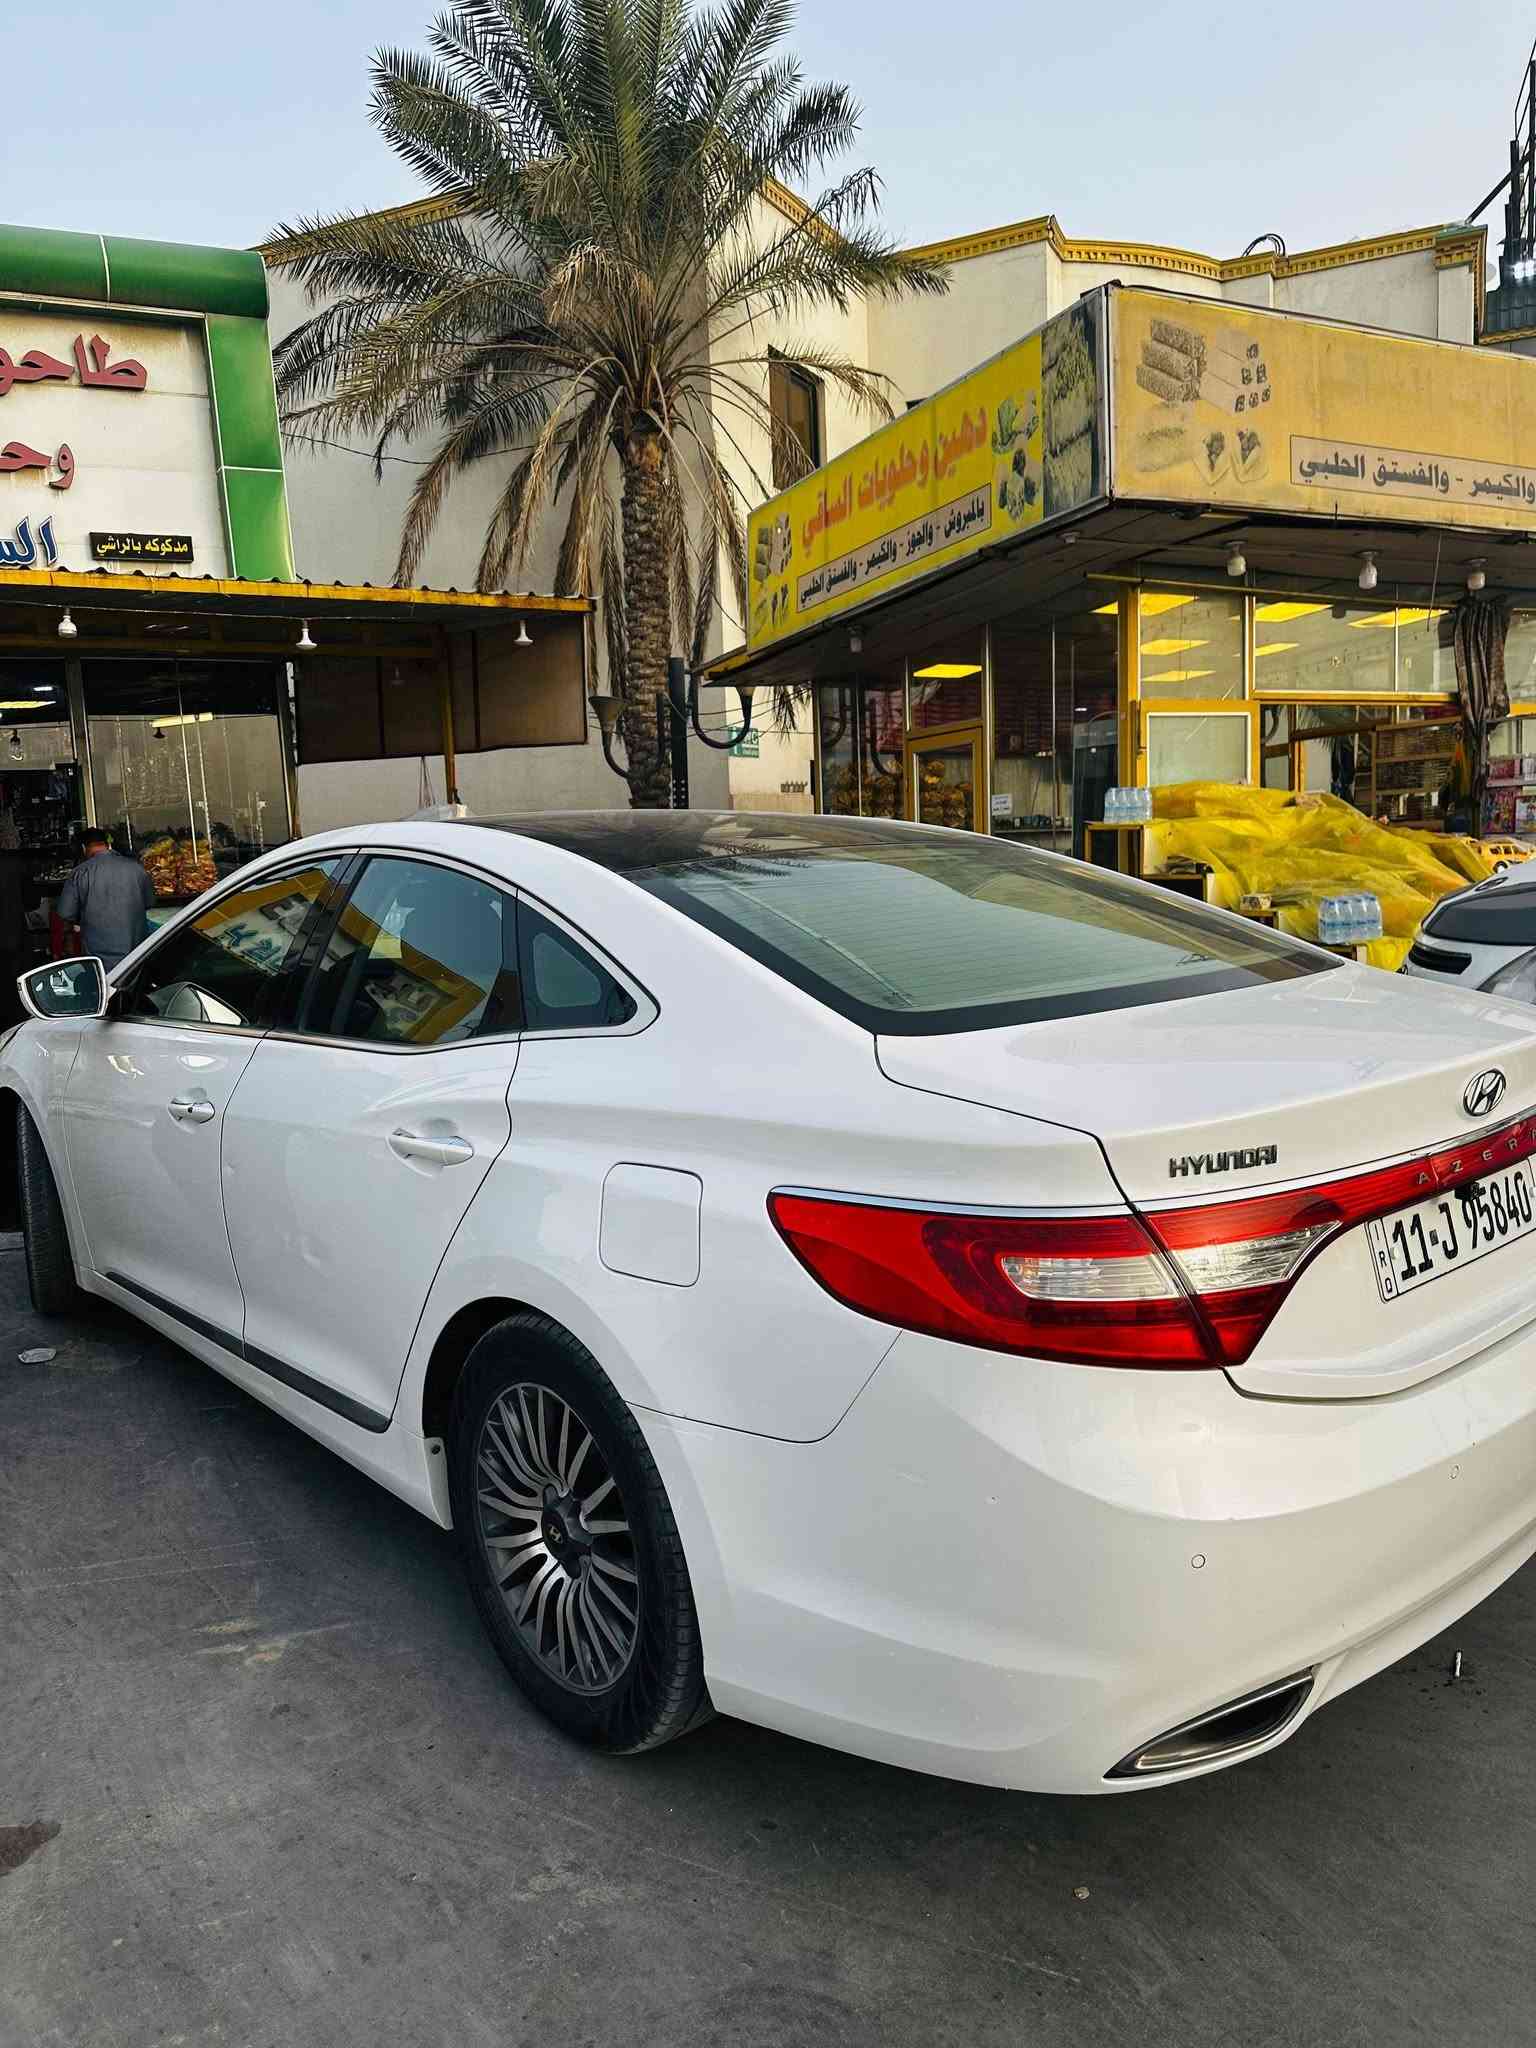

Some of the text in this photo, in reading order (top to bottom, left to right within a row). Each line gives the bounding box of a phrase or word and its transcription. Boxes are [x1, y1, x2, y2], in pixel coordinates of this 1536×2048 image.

[1299, 451, 1366, 484] الحلبي
[1372, 456, 1450, 494] والفستق
[96, 535, 142, 557] بالراشي
[1169, 1144, 1278, 1178] HYUNDAI
[1461, 1170, 1532, 1250] 95840
